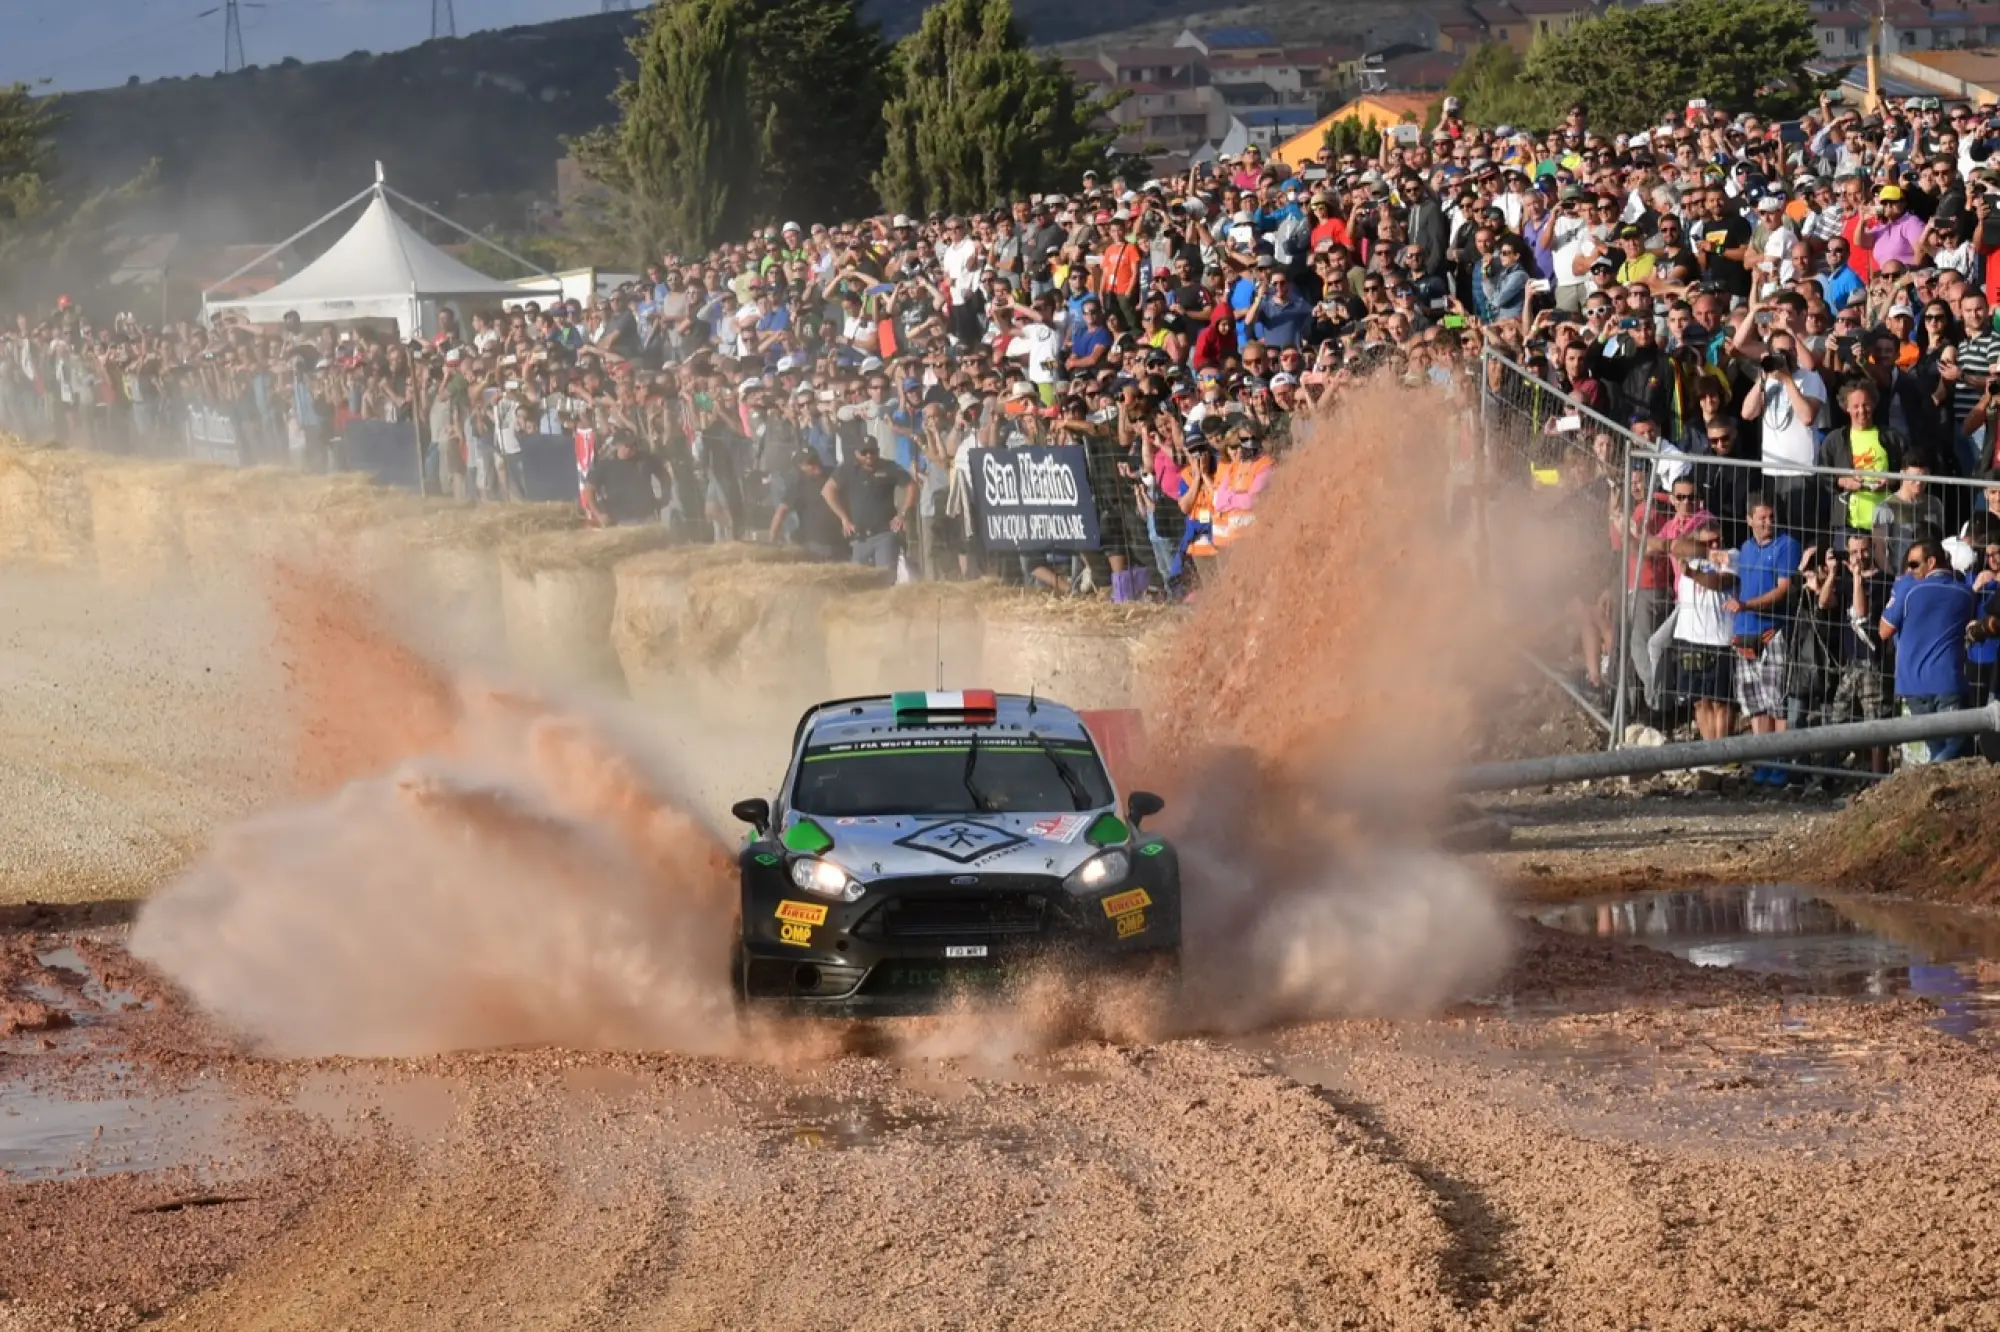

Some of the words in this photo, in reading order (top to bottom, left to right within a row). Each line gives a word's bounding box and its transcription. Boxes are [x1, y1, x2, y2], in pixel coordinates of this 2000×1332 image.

[983, 452, 1019, 506] San
[1016, 452, 1078, 507] Martino
[1029, 514, 1086, 540] SPETTACOLARE
[880, 740, 912, 748] World
[943, 738, 1017, 746] Chamionship
[780, 903, 823, 921] PIRELLI
[1107, 891, 1145, 914] PIRELLI
[780, 924, 812, 943] OMP
[1117, 913, 1145, 936] OMP
